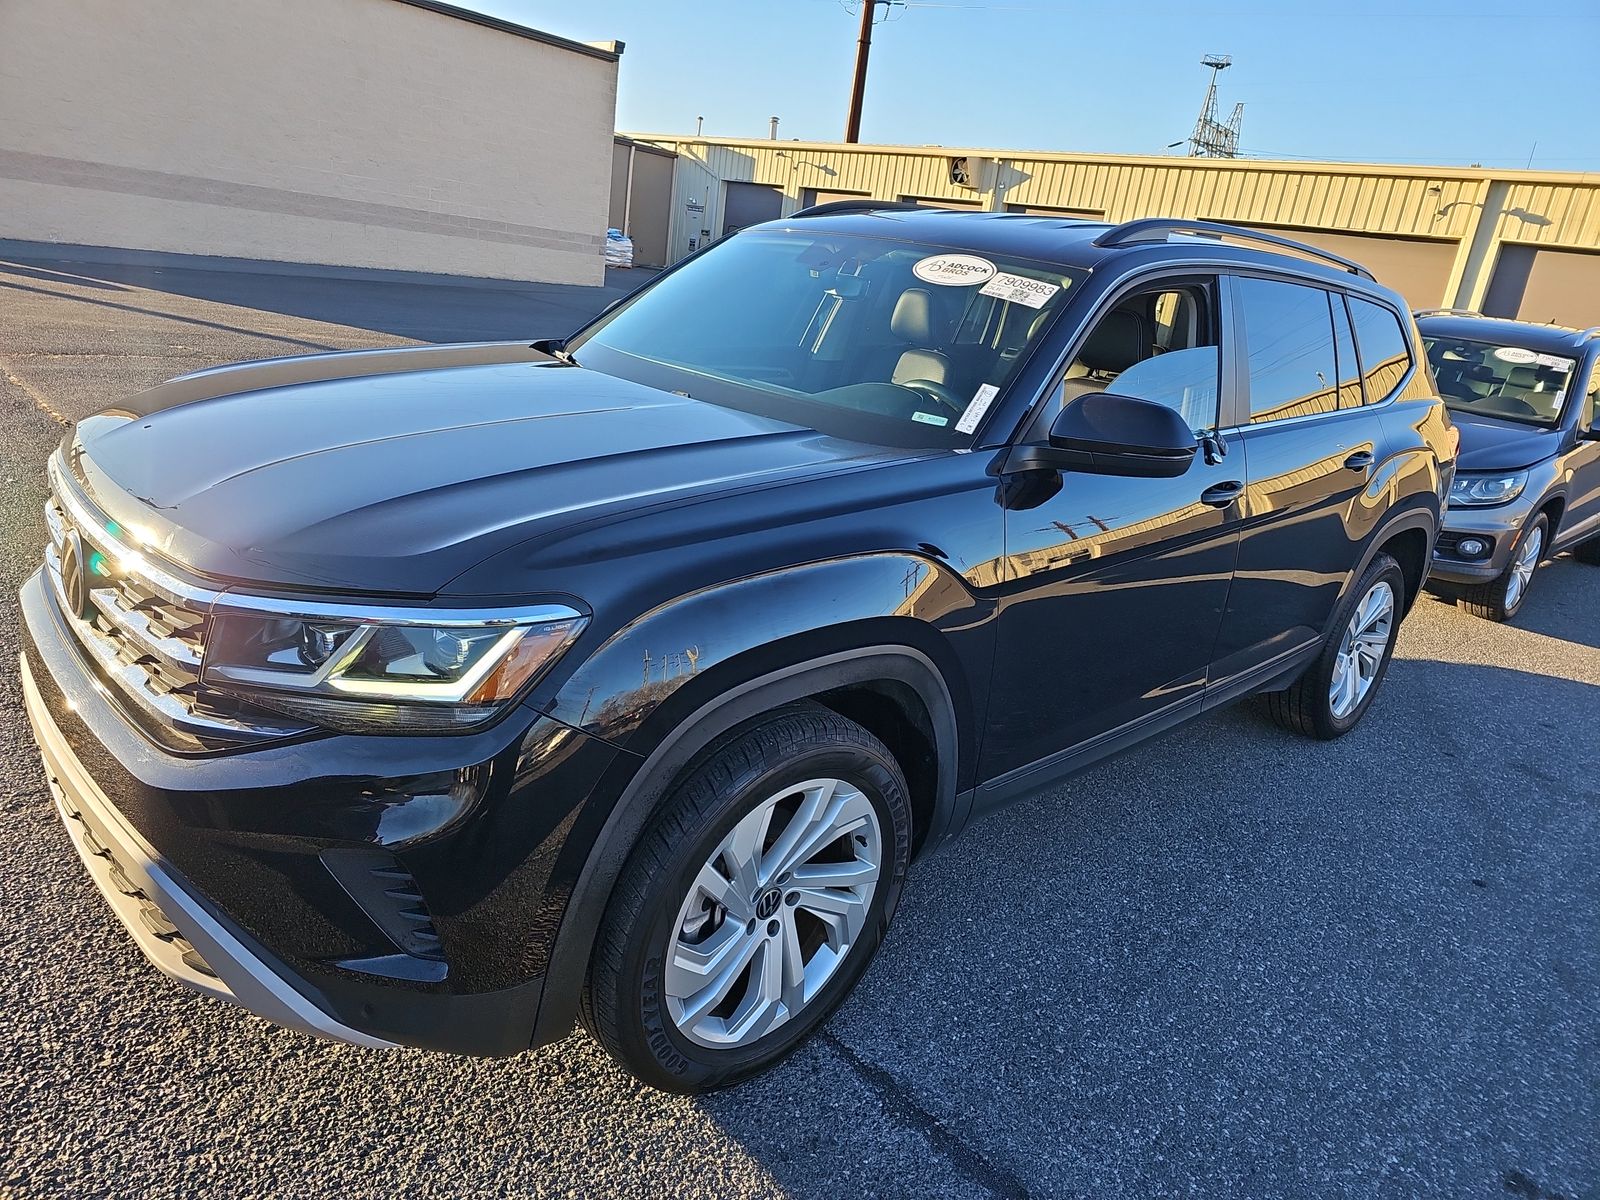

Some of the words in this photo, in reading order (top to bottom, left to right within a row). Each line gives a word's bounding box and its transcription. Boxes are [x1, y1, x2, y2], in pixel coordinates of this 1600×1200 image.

[941, 268, 970, 276] BROS
[947, 262, 990, 274] ADCOCK
[997, 275, 1055, 296] 7909983
[881, 779, 907, 885] ASSURANCE
[641, 957, 689, 1075] GOODYEAR
